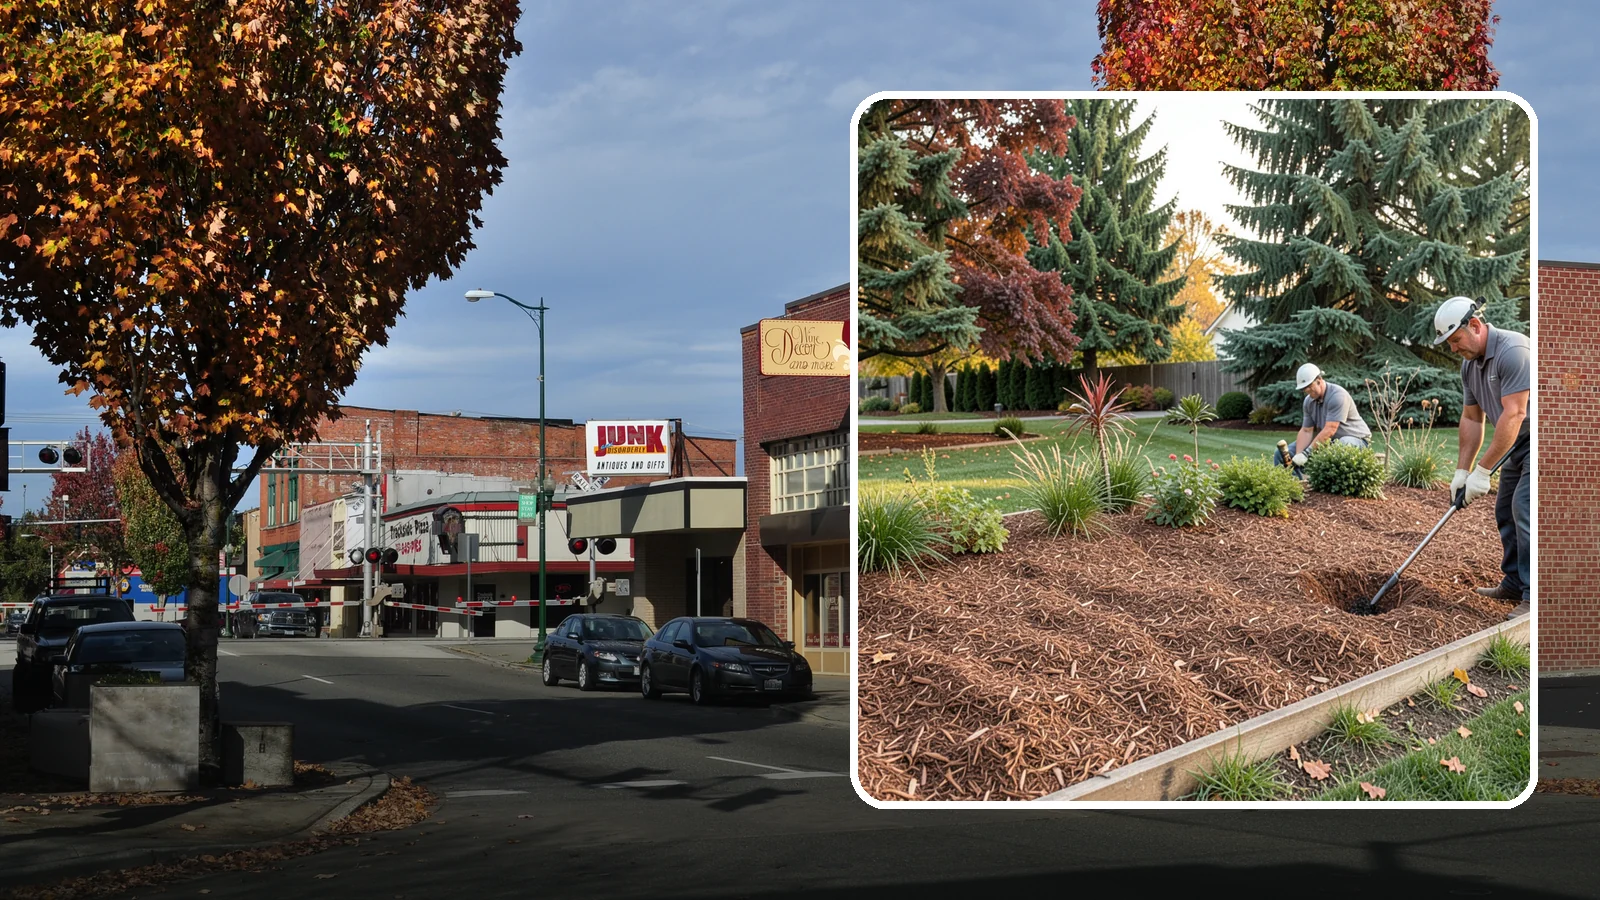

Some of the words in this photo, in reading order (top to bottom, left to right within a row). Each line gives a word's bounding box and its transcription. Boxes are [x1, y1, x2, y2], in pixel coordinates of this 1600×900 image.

[765, 328, 831, 365] Decor
[595, 425, 665, 457] JUNK
[607, 446, 646, 454] DISORDERLY
[596, 461, 628, 470] ANTIQUES
[631, 461, 644, 470] AND
[647, 460, 665, 469] GIFTS
[352, 498, 364, 511] CRO
[390, 521, 413, 540] Trackside
[414, 519, 429, 535] Pizza
